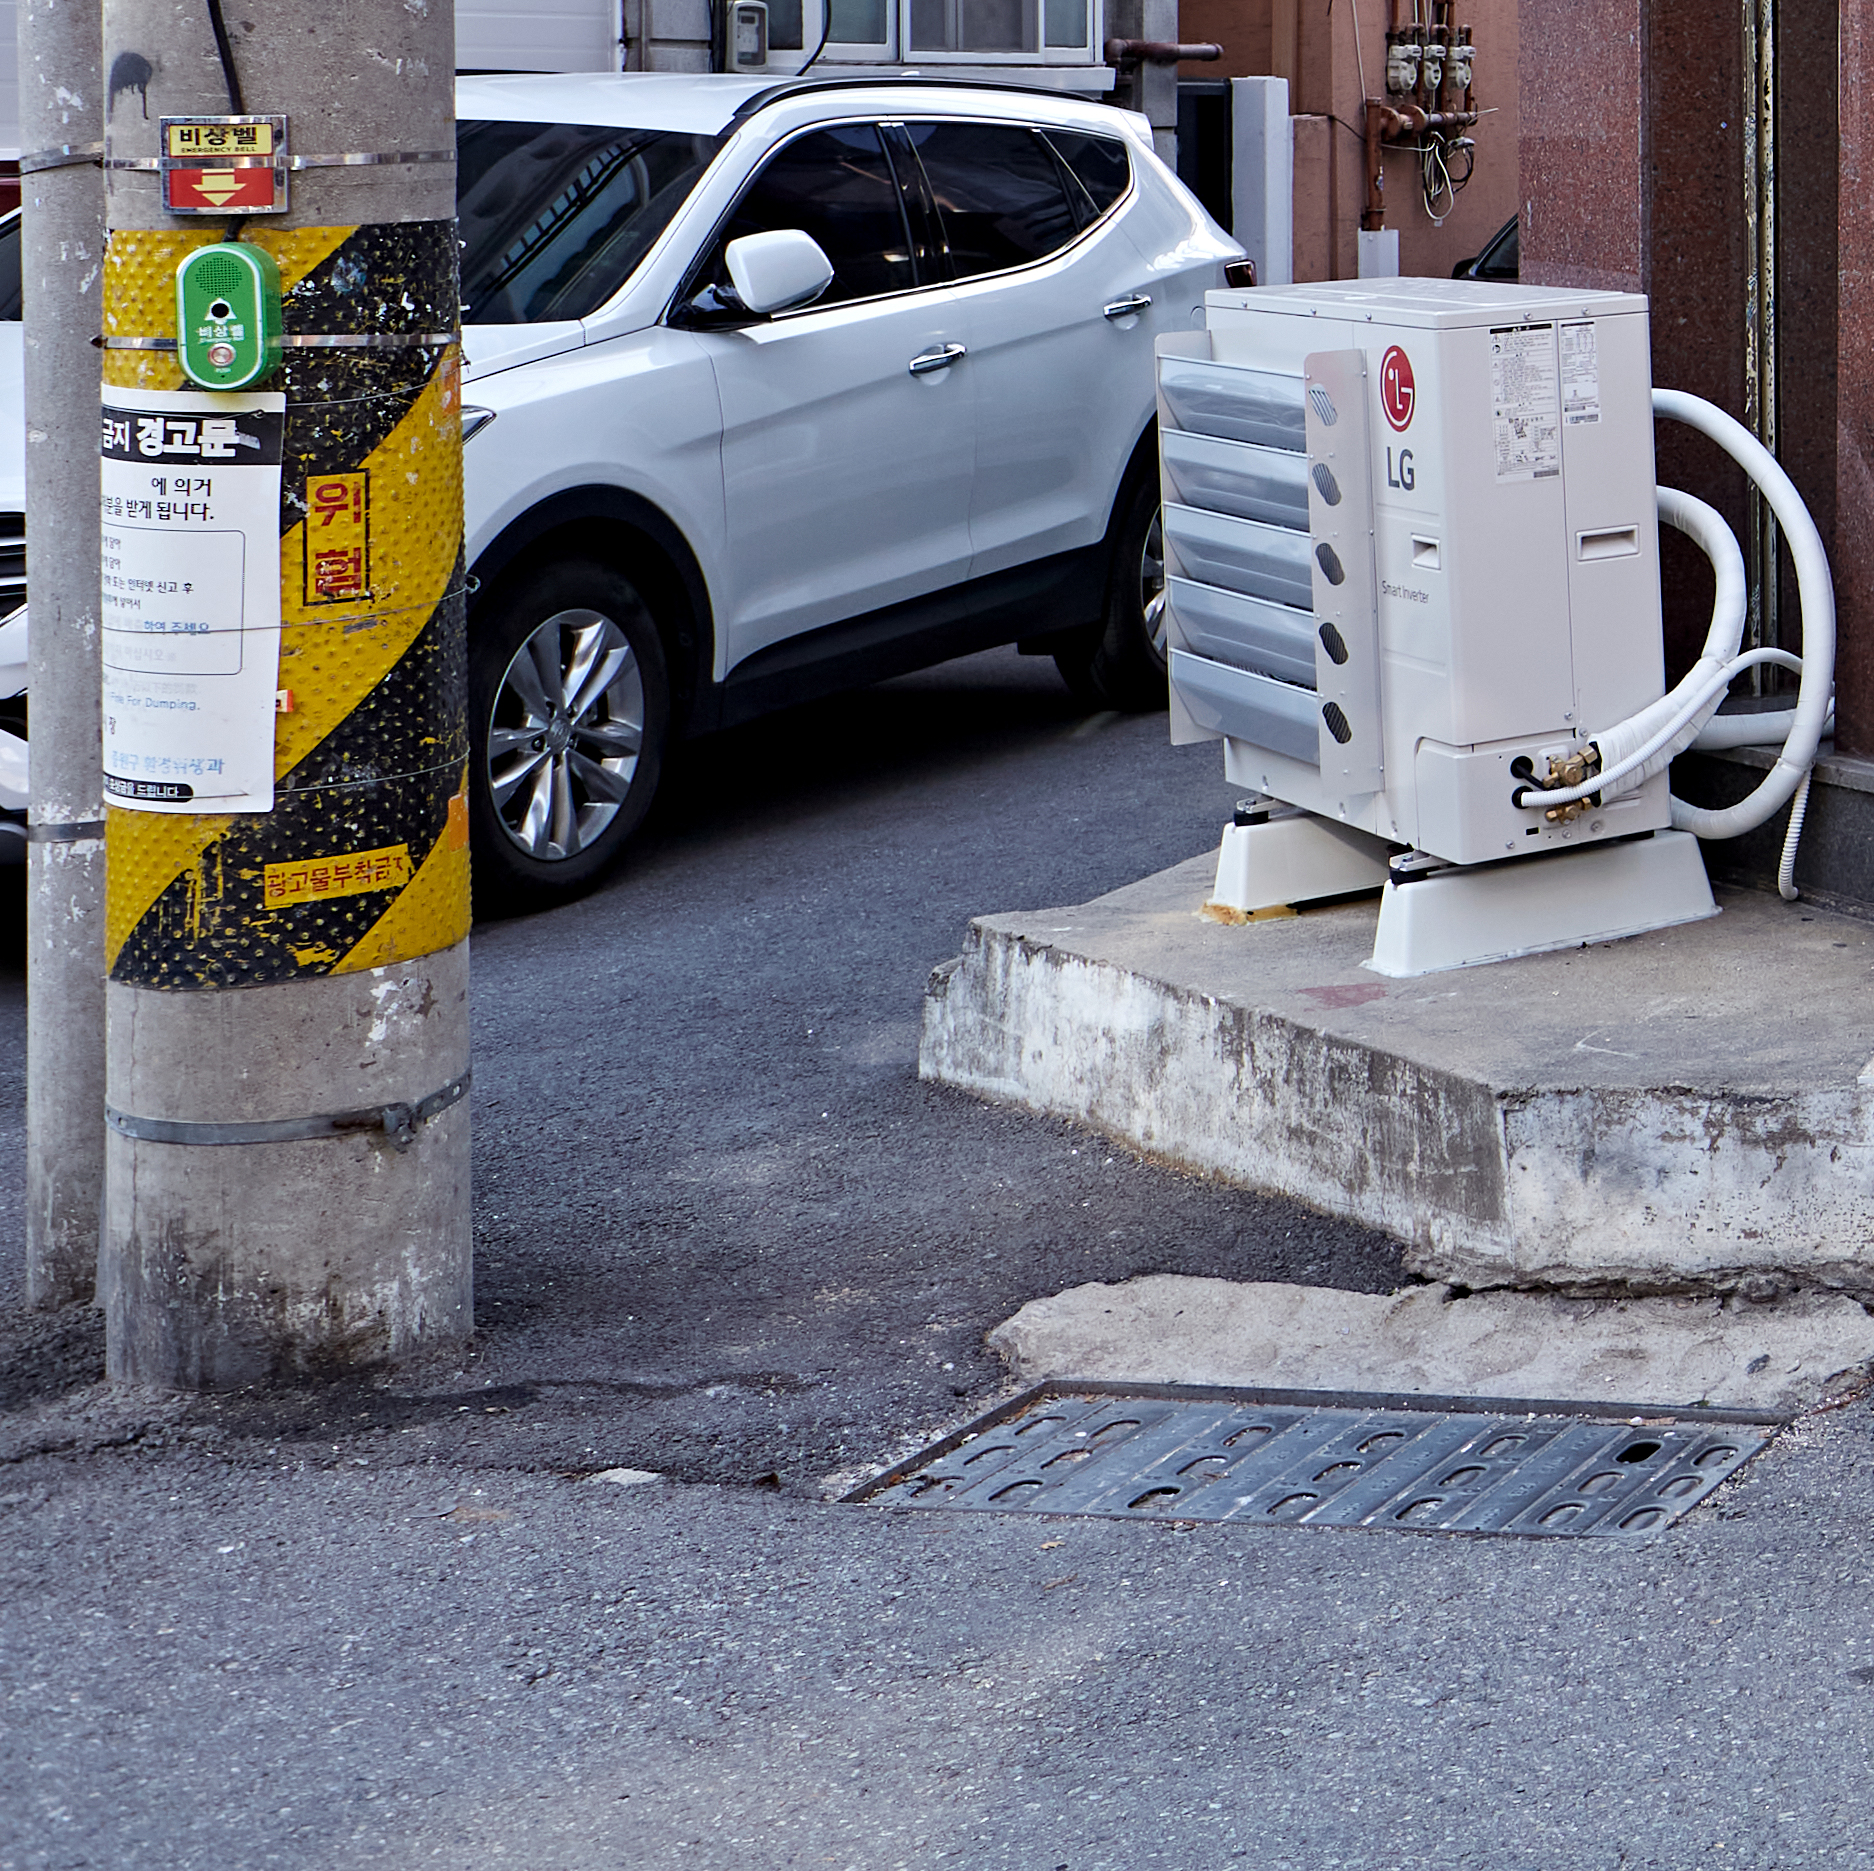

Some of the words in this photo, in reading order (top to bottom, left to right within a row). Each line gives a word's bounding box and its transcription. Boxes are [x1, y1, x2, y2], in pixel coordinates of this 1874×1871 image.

[179, 127, 258, 146] 비상벨
[136, 417, 240, 458] 경고문
[1386, 446, 1416, 492] LG
[174, 478, 212, 497] 의거
[126, 499, 152, 519] 받게
[156, 501, 215, 522] 됩니다.
[156, 581, 178, 594] 신고
